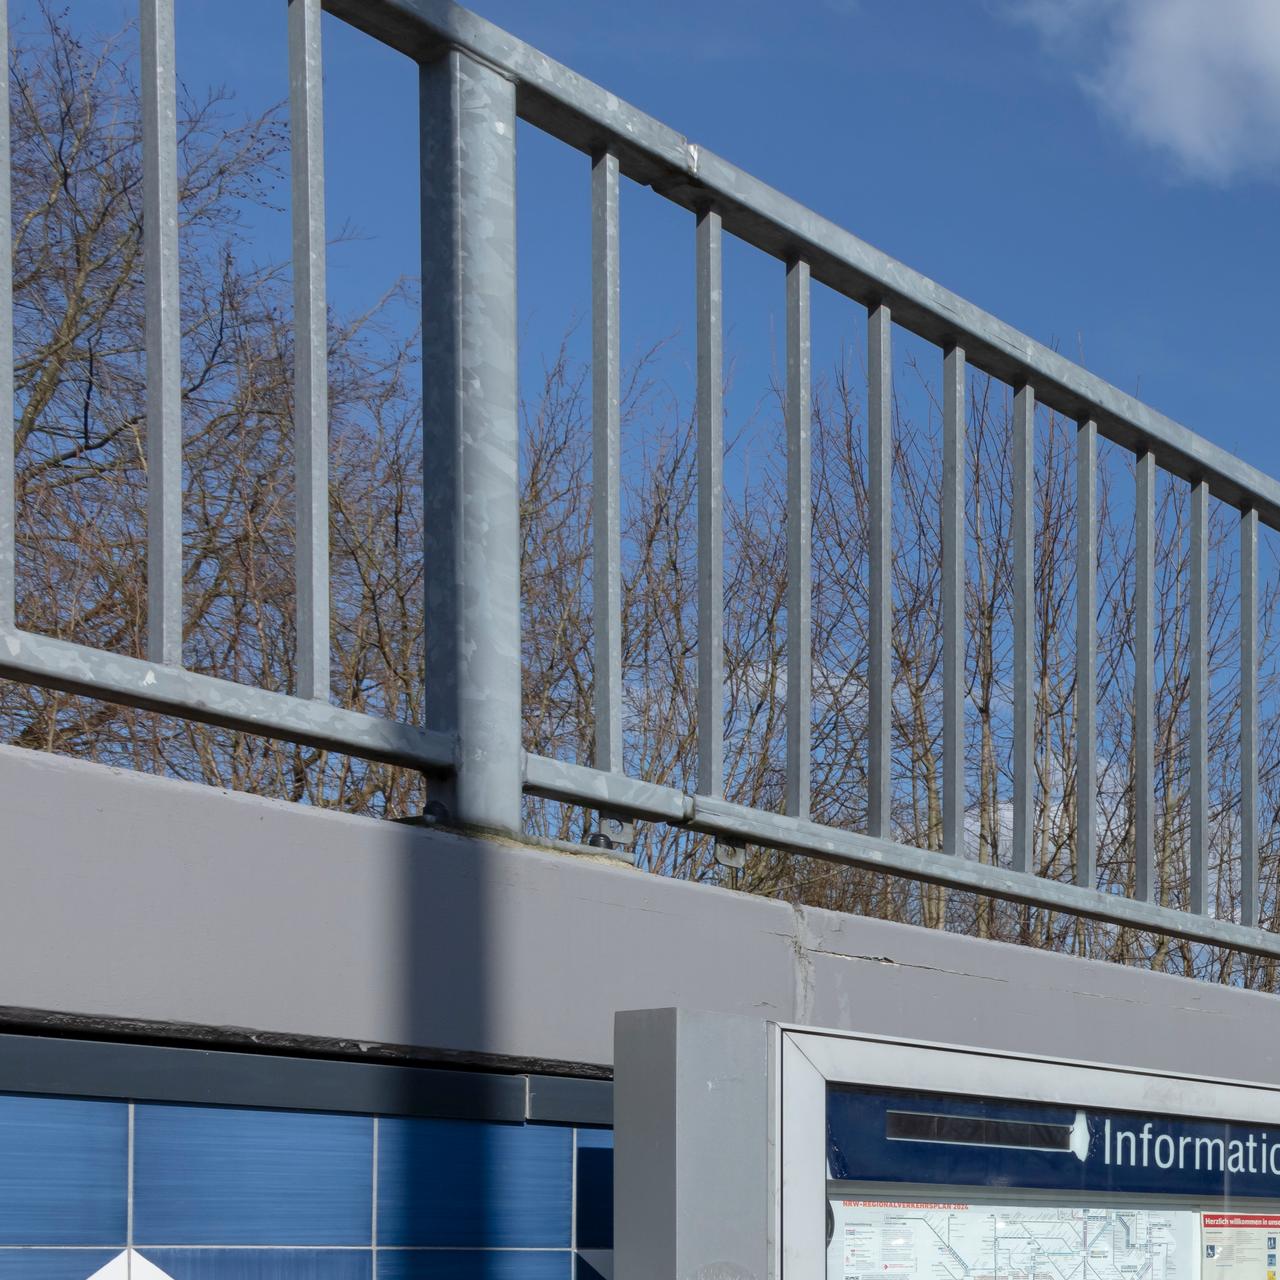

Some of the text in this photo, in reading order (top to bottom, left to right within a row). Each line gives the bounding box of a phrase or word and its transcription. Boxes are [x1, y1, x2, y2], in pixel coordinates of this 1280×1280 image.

[1205, 1217, 1229, 1225] Herzlich
[1230, 1218, 1262, 1226] willkommen
[1263, 1218, 1268, 1226] in
